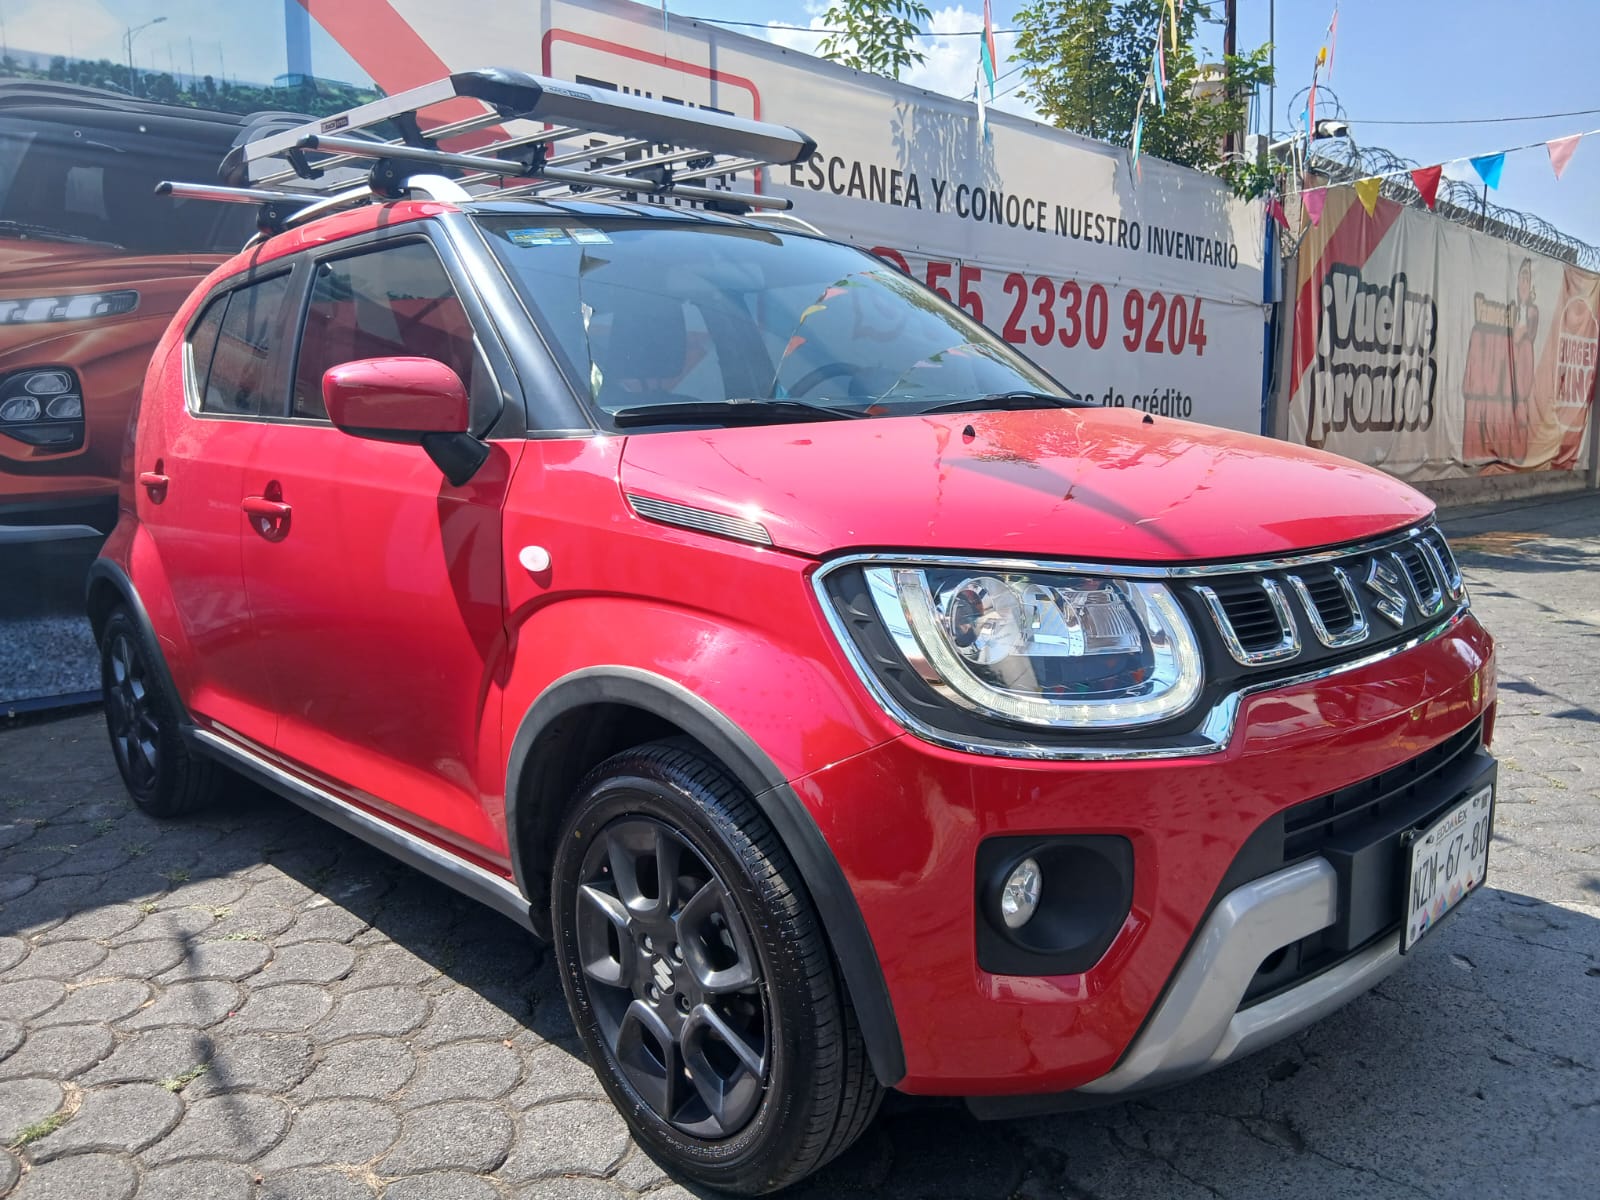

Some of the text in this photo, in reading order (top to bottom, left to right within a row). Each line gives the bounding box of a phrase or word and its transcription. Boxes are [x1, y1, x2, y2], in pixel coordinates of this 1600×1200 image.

[790, 152, 1238, 269] ESCANEA Y CONOCE NUESTRO INVENTARIO
[1003, 273, 1108, 350] 2330
[1123, 289, 1207, 356] 9204
[1318, 268, 1434, 357] ¡Vuelve
[1560, 336, 1598, 367] BURGER
[1103, 387, 1192, 418] de crédito
[1310, 365, 1434, 441] pronto!
[1413, 815, 1488, 916] NZM-67-80
